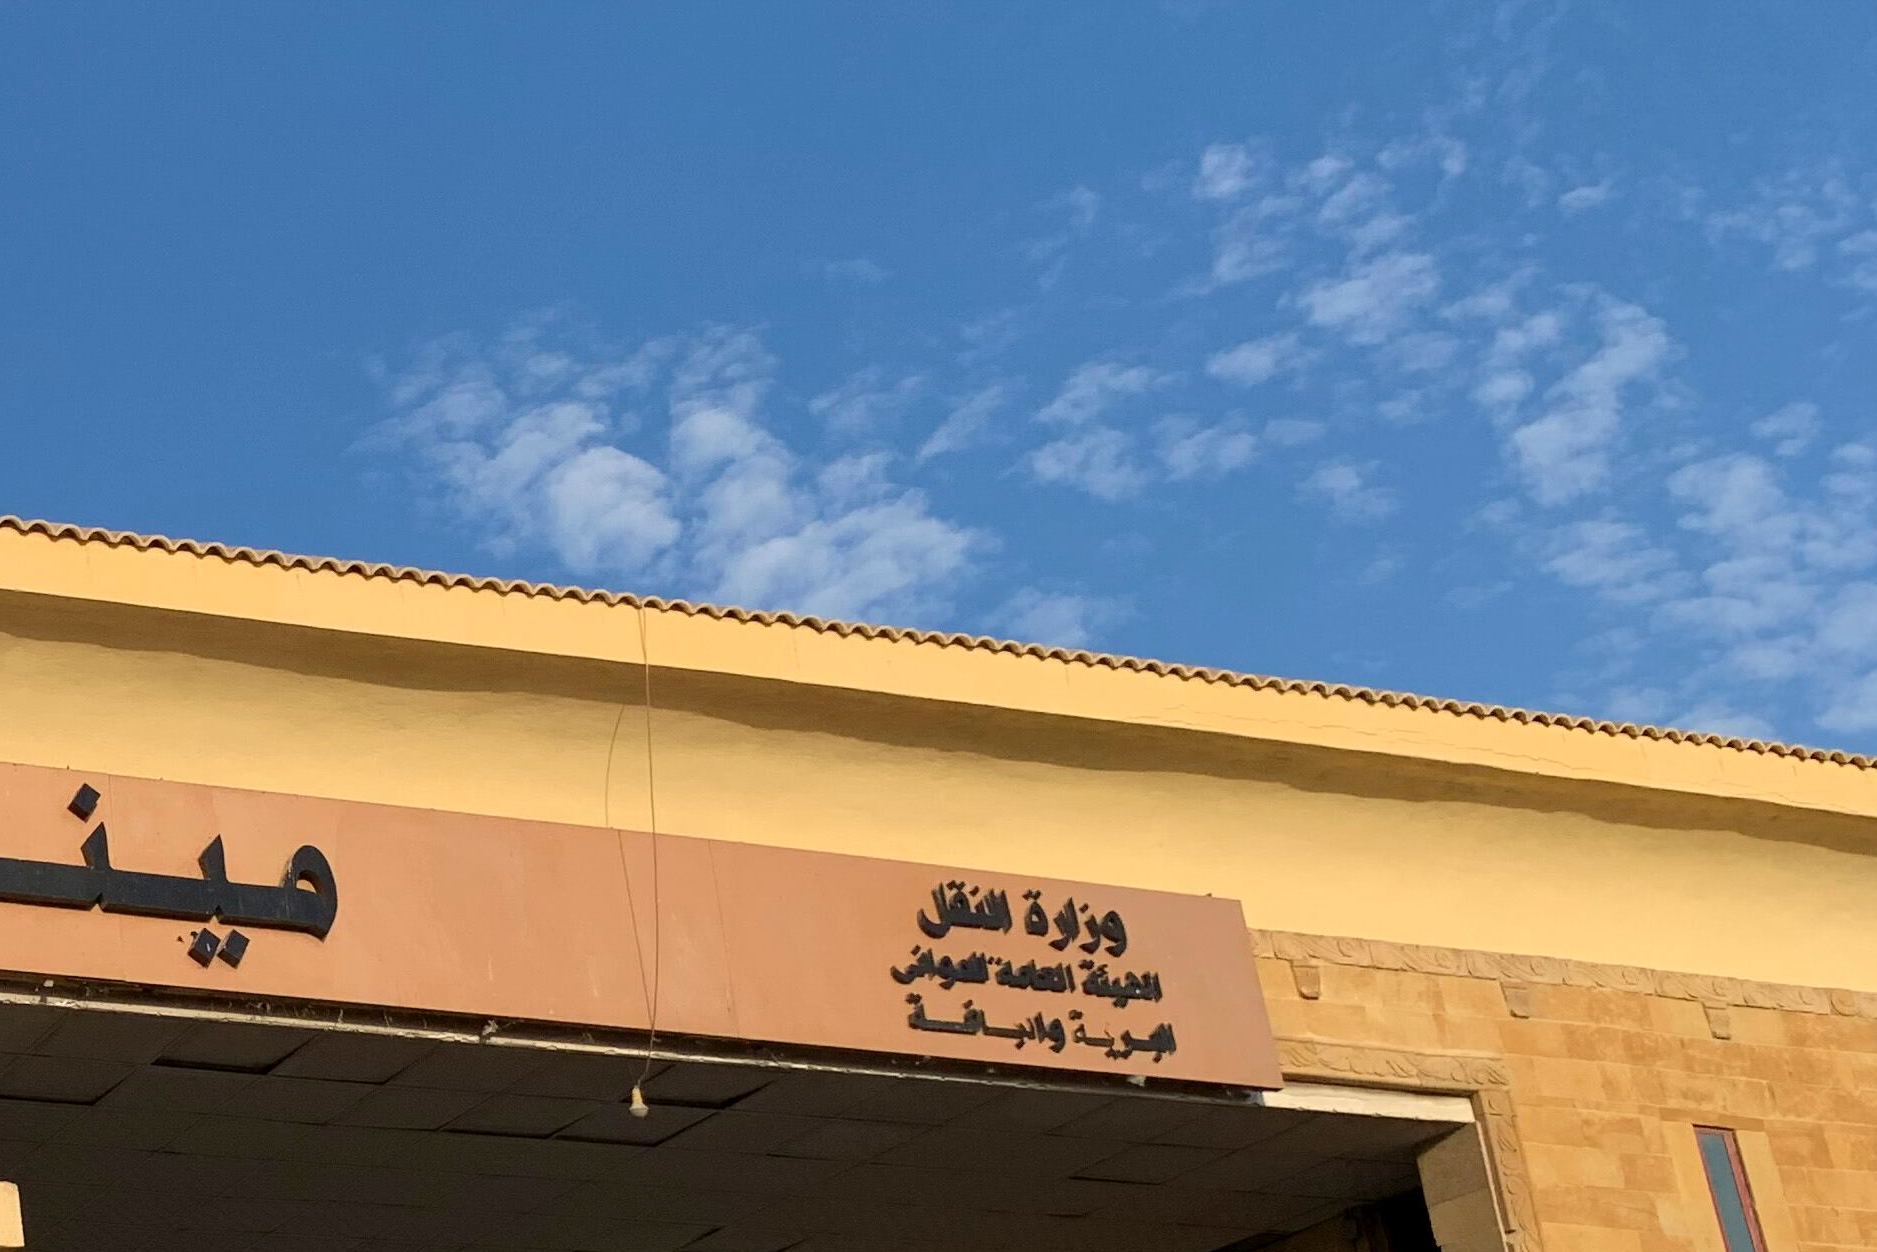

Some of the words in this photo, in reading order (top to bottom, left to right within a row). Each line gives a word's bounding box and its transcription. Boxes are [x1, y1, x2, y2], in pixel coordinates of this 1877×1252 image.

[917, 880, 1012, 939] النقل
[1022, 889, 1127, 957] وزارة
[988, 956, 1076, 993] العامة
[1078, 959, 1162, 1008] الهيئة
[905, 993, 1066, 1053] والجافة
[1069, 1009, 1176, 1063] البرية
